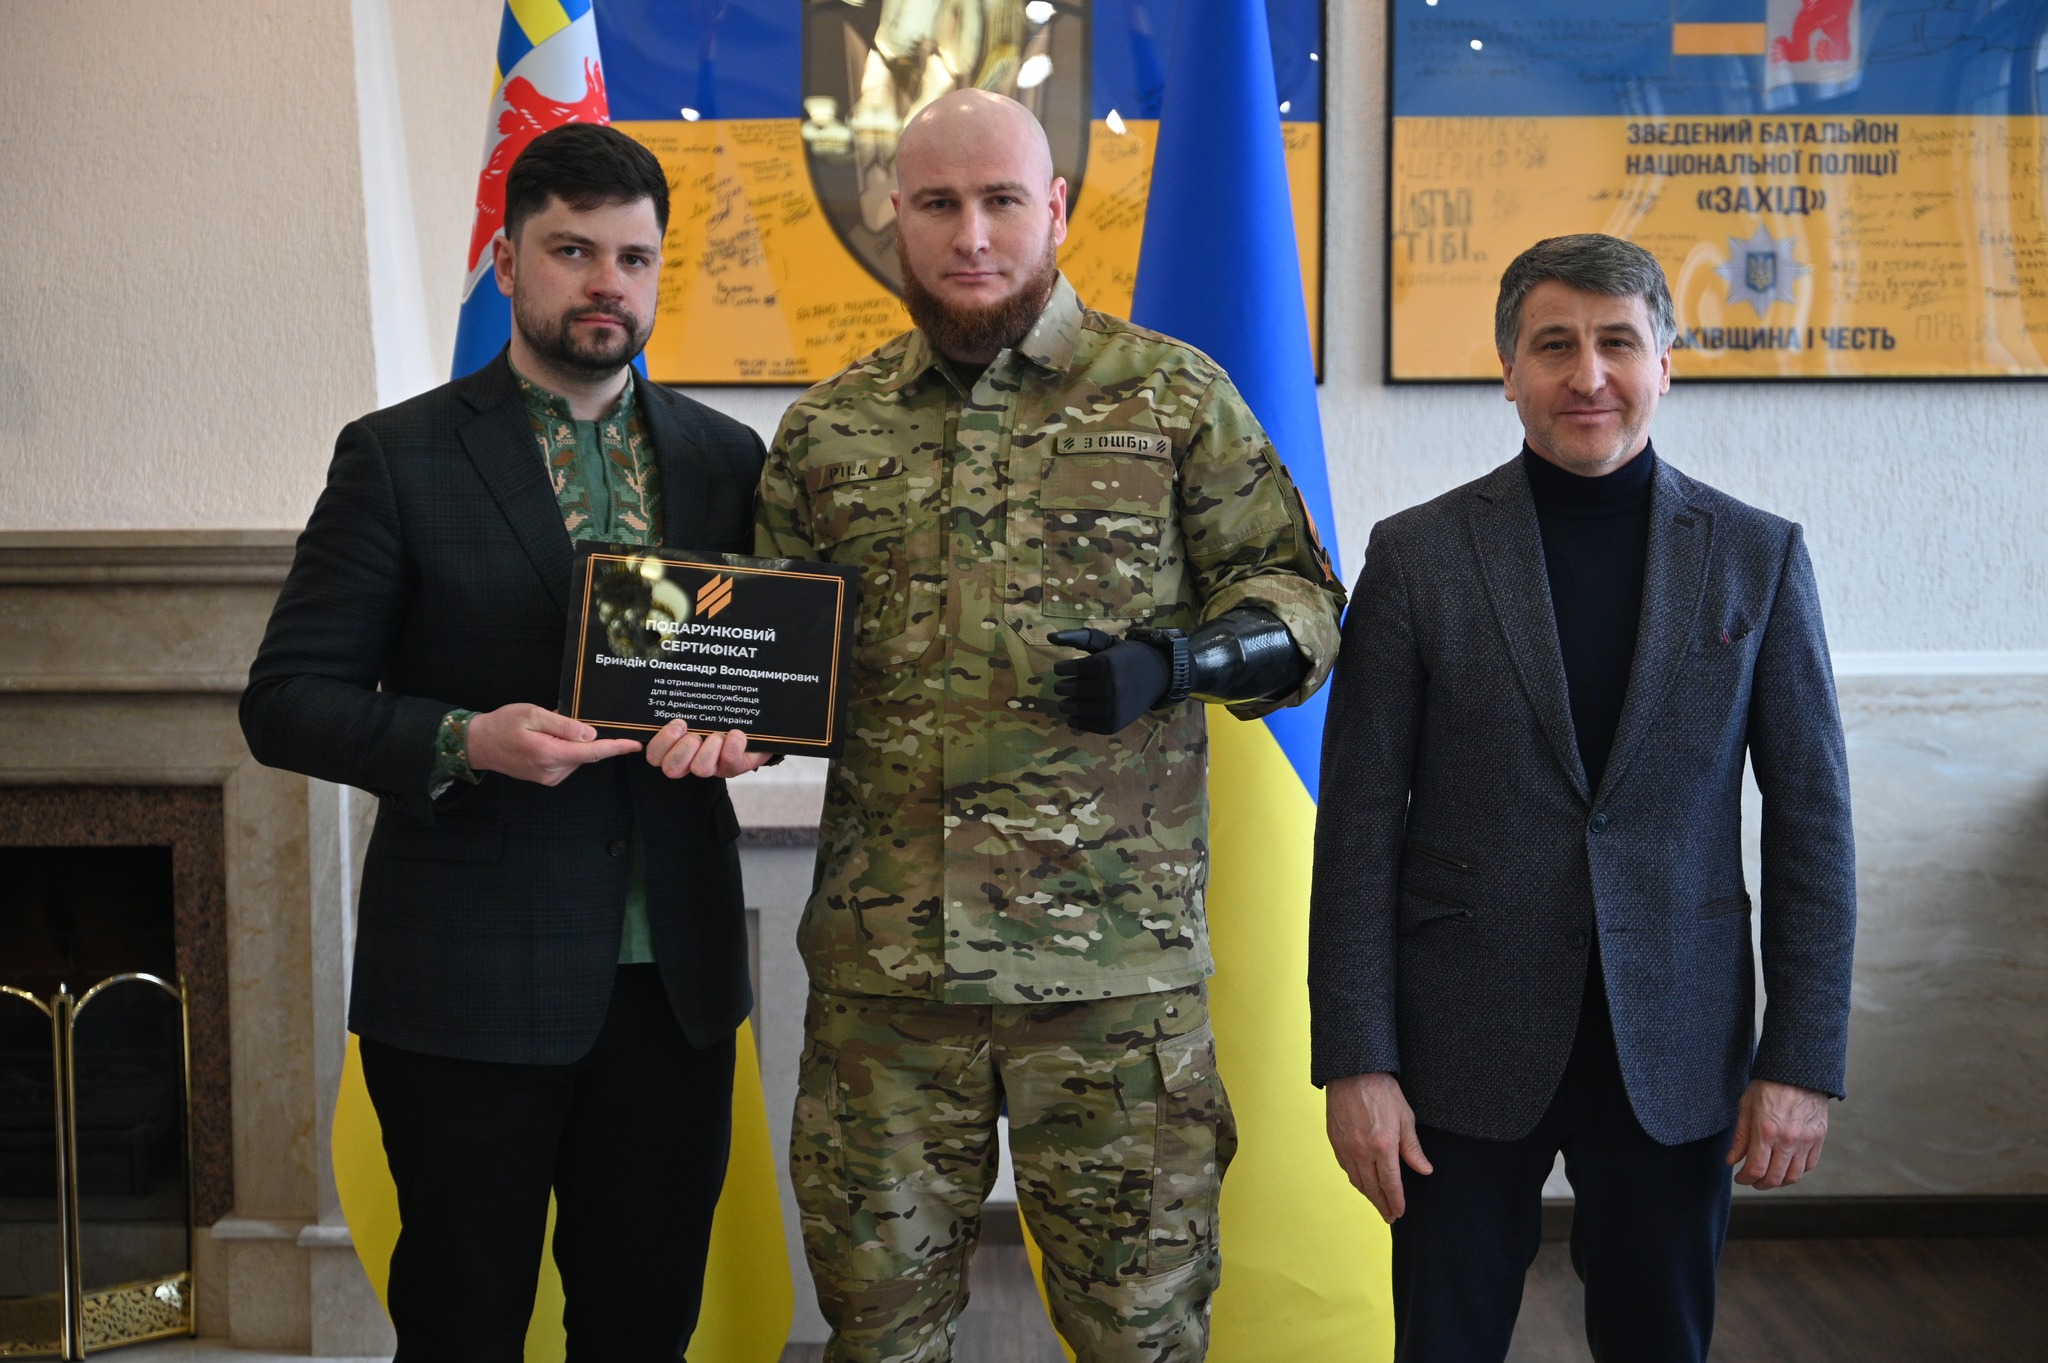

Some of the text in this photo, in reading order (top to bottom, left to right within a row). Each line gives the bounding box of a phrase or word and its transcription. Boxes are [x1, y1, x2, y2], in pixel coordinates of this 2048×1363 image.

[1627, 119, 1752, 145] ЗВЕДЕНИЙ
[1759, 119, 1898, 145] БАТАЛЬЙОН
[1625, 150, 1900, 176] НАЦІОНАЛЬНОЇ ПОЛІЦІЇ
[1696, 186, 1827, 215] «ЗАХІД»
[1671, 326, 1897, 351] ЬКІВЩИНА І ЧЕСТЬ
[829, 464, 868, 480] PILA
[645, 619, 776, 642] ПОДАРУНКОВИЙ
[660, 639, 758, 659] СЕРТИФІКАТ
[595, 654, 820, 683] Бриндін Олександр Володимирович
[650, 688, 760, 704] для військовослужбовця
[666, 679, 715, 689] отримання
[716, 683, 759, 693] квартири
[647, 698, 761, 717] 3-го Армійського Корпусу
[653, 709, 753, 726] Збройних Сил України
